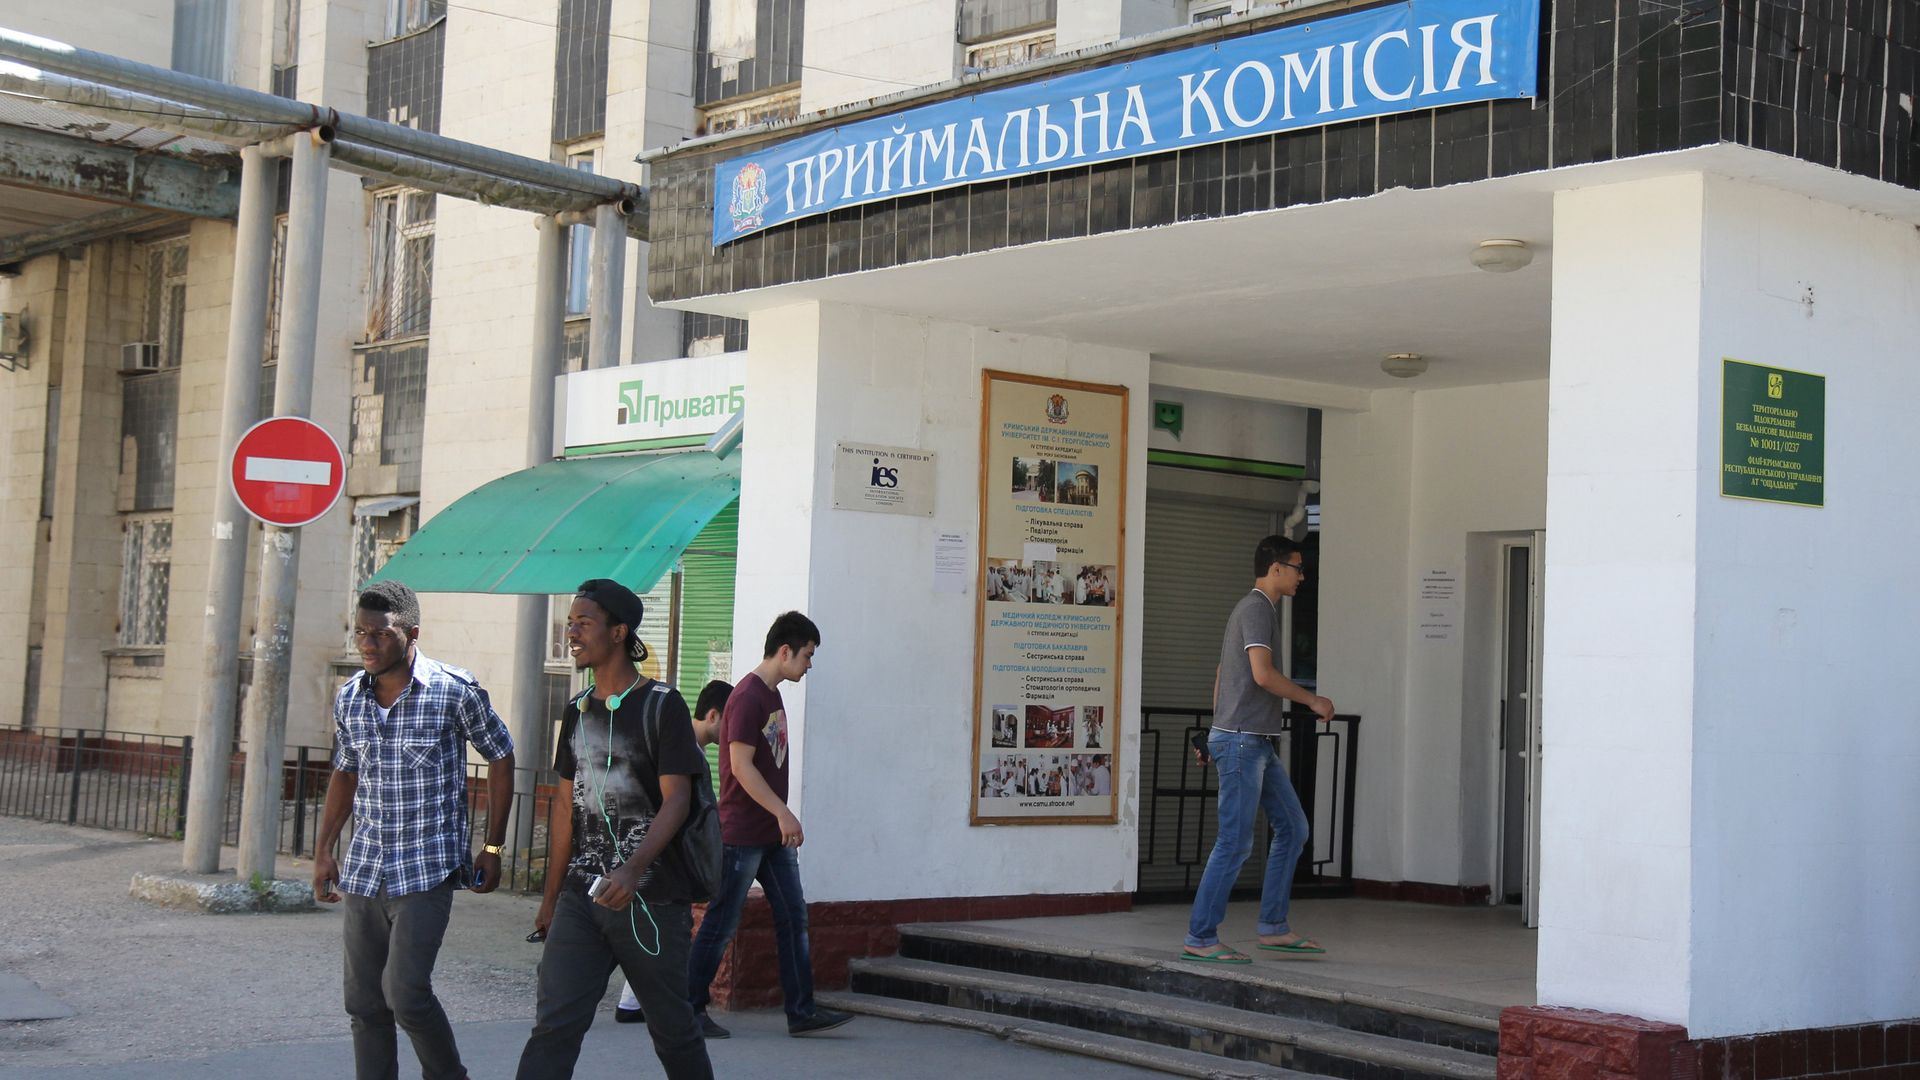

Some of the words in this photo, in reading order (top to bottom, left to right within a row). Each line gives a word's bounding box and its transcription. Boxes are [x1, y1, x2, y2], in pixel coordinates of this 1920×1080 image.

[785, 85, 1157, 215] ПРИЙМАЛЬНА
[1178, 14, 1499, 140] КОМІСІЯ
[1752, 404, 1798, 418] ТЕРИТОРІАЛЬНО
[1753, 414, 1796, 429] ВІДОКРЕМЛЕНЕ
[1003, 423, 1040, 432] КРИМСЬКИЙ
[1041, 427, 1079, 436] ДЕРЖАВНИЙ
[1078, 431, 1109, 440] МЕДИЧНИЙ
[1735, 422, 1779, 437] БЕЗБАЛАНСОВЕ
[1001, 431, 1041, 441] УНІВЕРСИТЕТ
[1761, 439, 1800, 453] 10011/0237
[855, 449, 889, 458] INSTITUTION
[897, 453, 922, 461] CERTIFIED
[870, 458, 899, 489] ies
[1015, 504, 1053, 514] ПІДГОТОВКА
[1053, 507, 1093, 517] СПЕЦІАЛІСТІВ
[1030, 518, 1063, 527] Лікувальна
[1030, 527, 1058, 536] Педіатрія
[1029, 535, 1068, 544] Стоматологія
[1002, 611, 1036, 620] МЕДИЧНИЙ
[1036, 613, 1062, 621] КОЛЕДЖ
[1062, 614, 1101, 623] КРИМСЬКОГО
[990, 620, 1034, 629] ДЕРЖАВНОГО
[1034, 621, 1070, 630] МЕДИЧНОГО
[1070, 622, 1111, 632] УНІВЕРСИТЕТУ
[1013, 642, 1051, 650] ПІДГОТОВКА
[1052, 643, 1088, 652] БАКАЛАВРІВ
[1026, 652, 1064, 661] Сестринська
[992, 664, 1030, 673] ПІДГОТОВКА
[1031, 665, 1066, 674] МОЛОДШИХ
[1066, 666, 1107, 675] СПЕЦІАЛІСТІВ
[1025, 675, 1063, 683] Сестринська
[1063, 676, 1084, 684] справа
[1025, 684, 1065, 692] Стоматологія
[1025, 692, 1055, 700] Фармація
